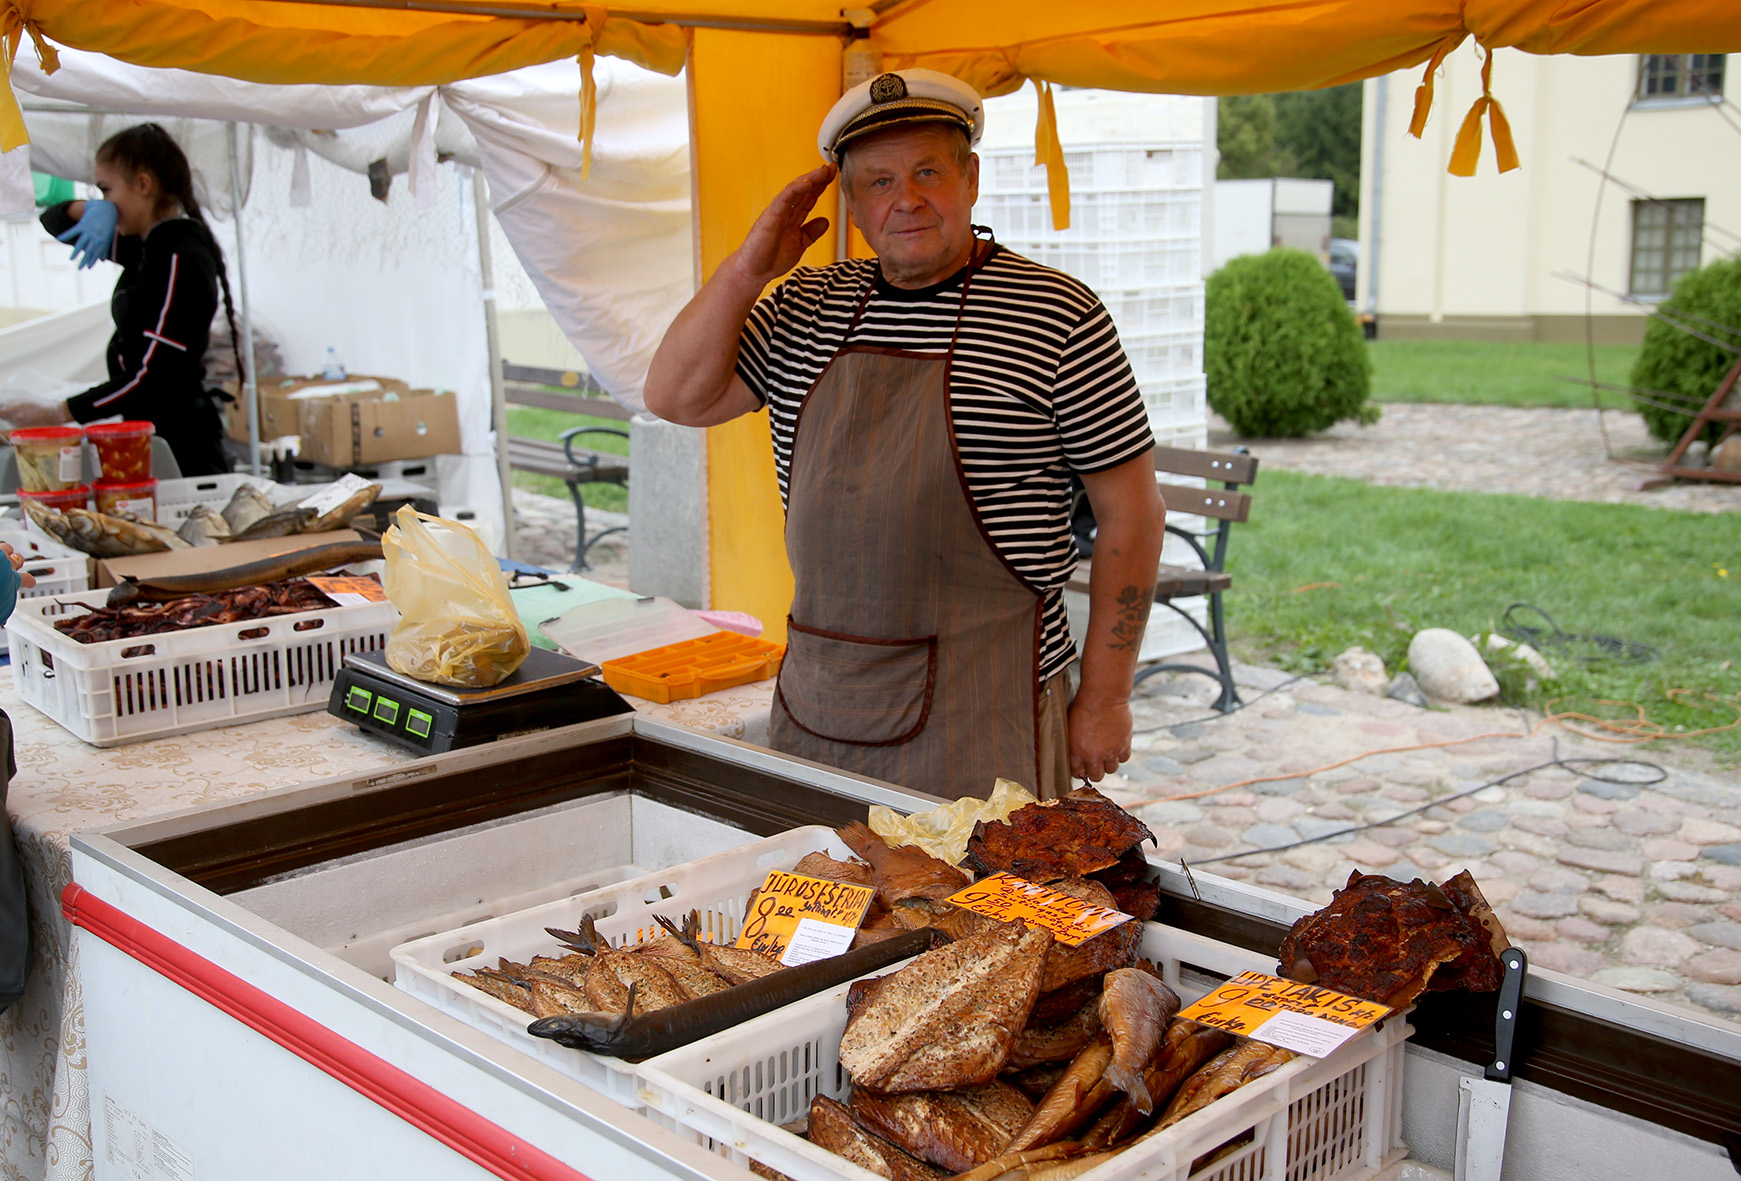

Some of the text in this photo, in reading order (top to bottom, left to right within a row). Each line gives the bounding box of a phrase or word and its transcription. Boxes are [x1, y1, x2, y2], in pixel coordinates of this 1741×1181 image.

[950, 892, 990, 904] 9
[745, 897, 776, 938] 8
[1198, 989, 1249, 1008] 9
